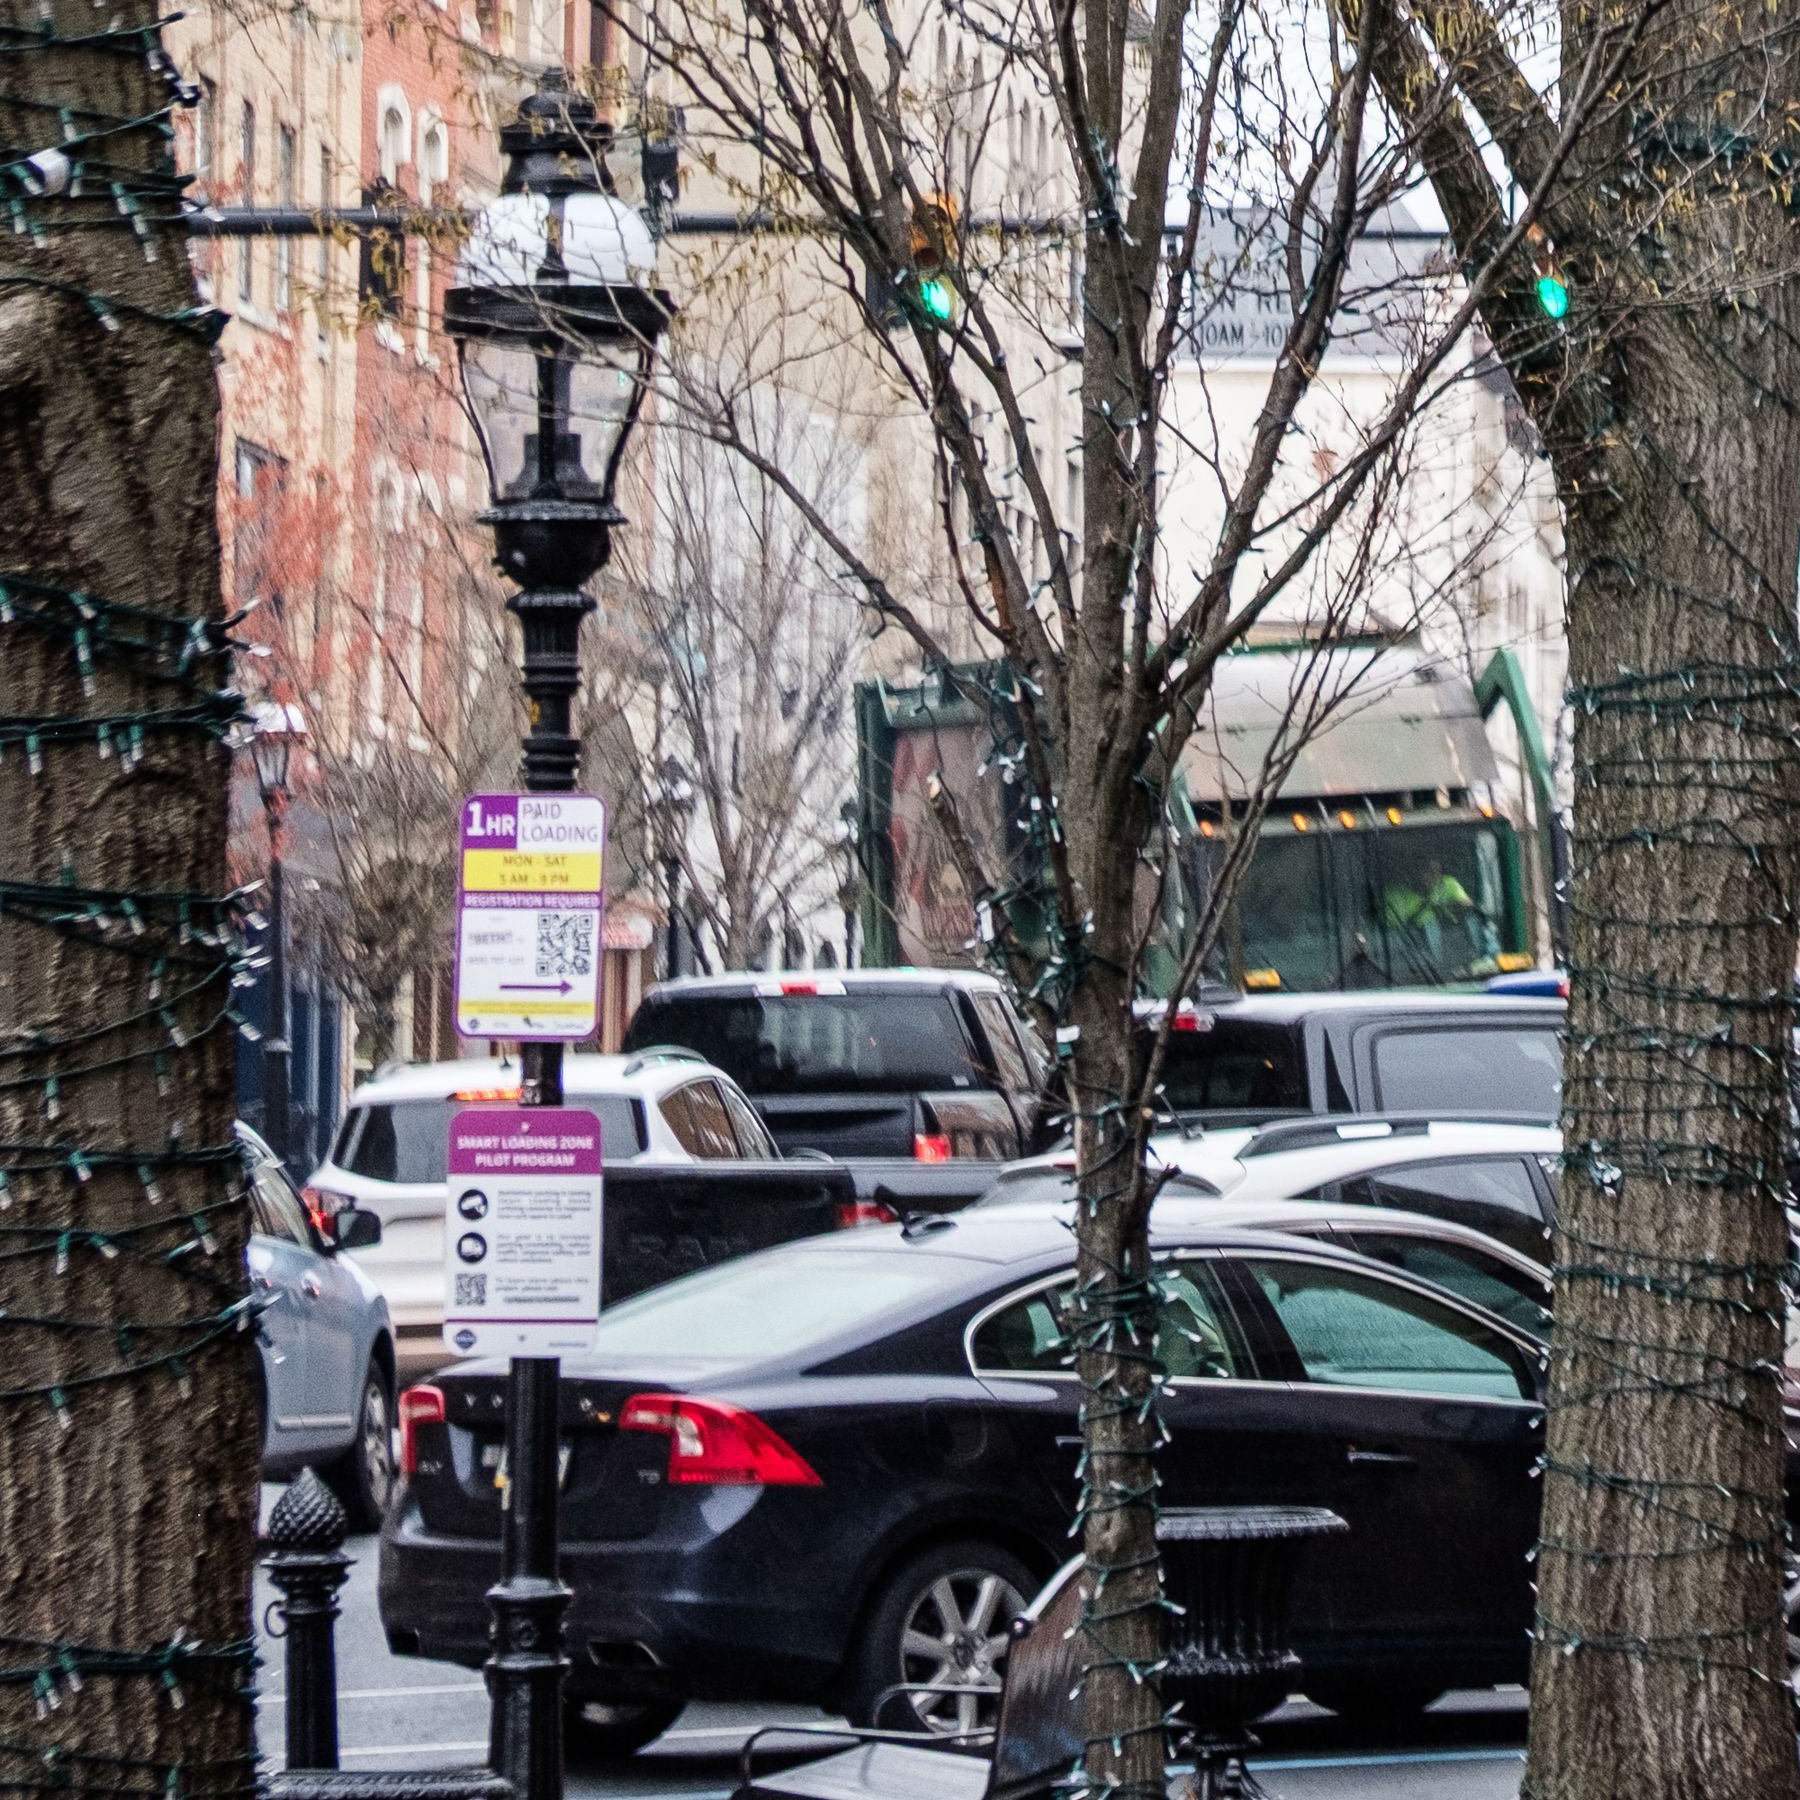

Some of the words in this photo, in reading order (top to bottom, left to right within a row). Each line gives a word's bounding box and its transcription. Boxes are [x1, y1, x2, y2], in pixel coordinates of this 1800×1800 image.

[522, 803, 561, 820] PAID
[521, 826, 599, 843] LOADING
[502, 856, 533, 867] MON
[544, 856, 568, 867] SAT
[464, 894, 543, 908] REGISTRATION
[544, 894, 600, 908] REQUIRED
[457, 1136, 500, 1150] SMART
[502, 1136, 558, 1150] LOADING
[559, 1136, 594, 1150] ZONE
[475, 1153, 511, 1167] PILOT
[513, 1153, 576, 1167] PROGRAM
